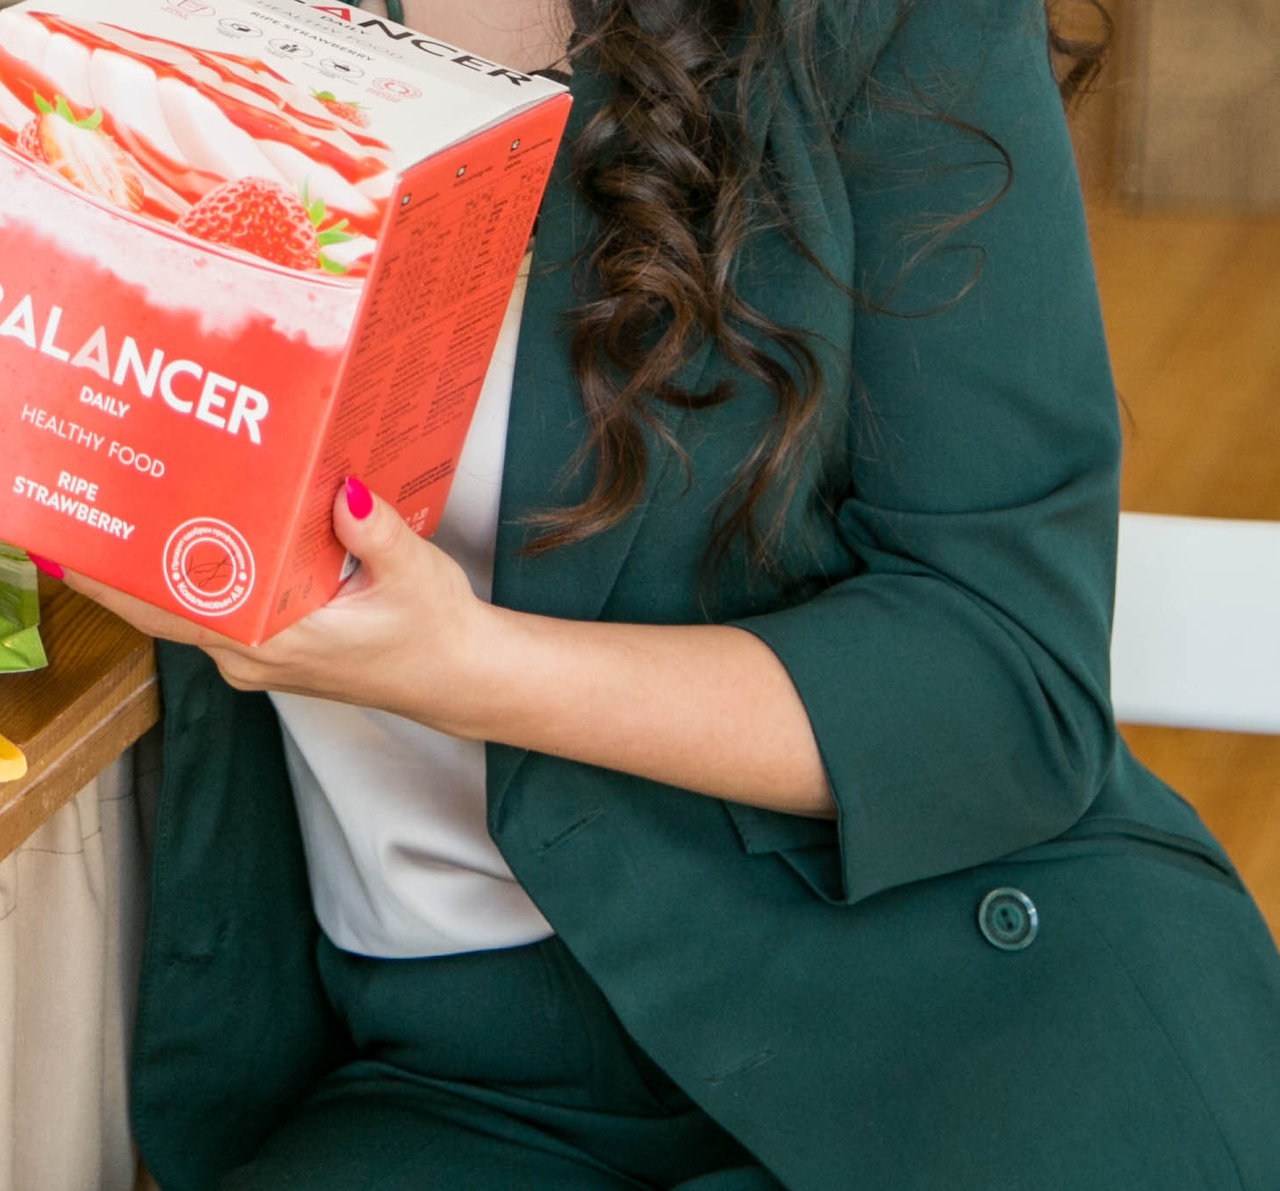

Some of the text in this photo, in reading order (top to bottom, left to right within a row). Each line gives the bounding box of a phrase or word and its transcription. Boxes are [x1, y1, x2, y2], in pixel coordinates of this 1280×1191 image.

[250, 11, 282, 25] RIPE
[282, 22, 376, 62] STRAWBERRY
[79, 385, 131, 419] DAILY
[21, 403, 166, 478] HEALTHY FOOD
[13, 475, 136, 540] STRAWBERRY
[57, 469, 99, 502] RIPE
